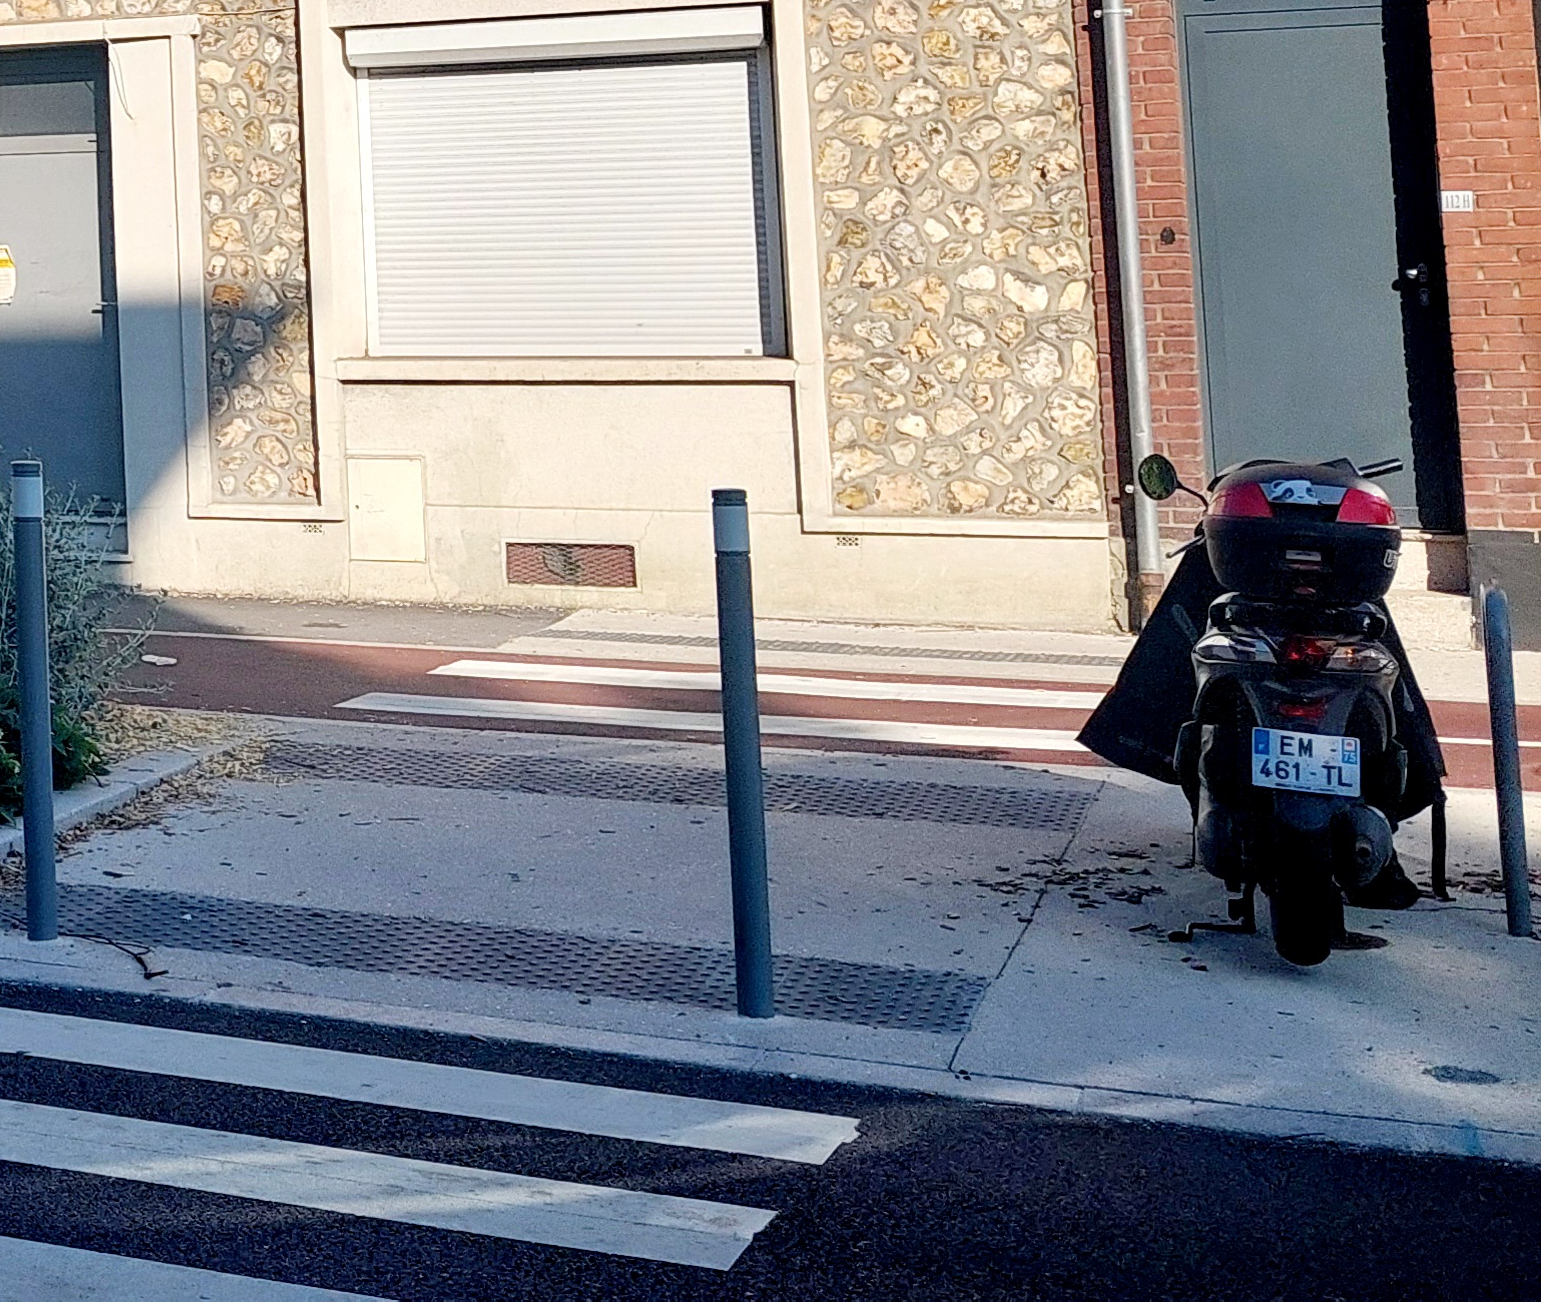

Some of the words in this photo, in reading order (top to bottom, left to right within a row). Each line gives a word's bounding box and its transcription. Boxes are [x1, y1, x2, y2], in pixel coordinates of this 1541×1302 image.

[1445, 194, 1461, 209] 112
[1462, 194, 1471, 209] H
[1279, 735, 1313, 758] EM
[1343, 751, 1357, 762] 75
[1259, 758, 1301, 782] 461
[1321, 764, 1353, 788] TL
